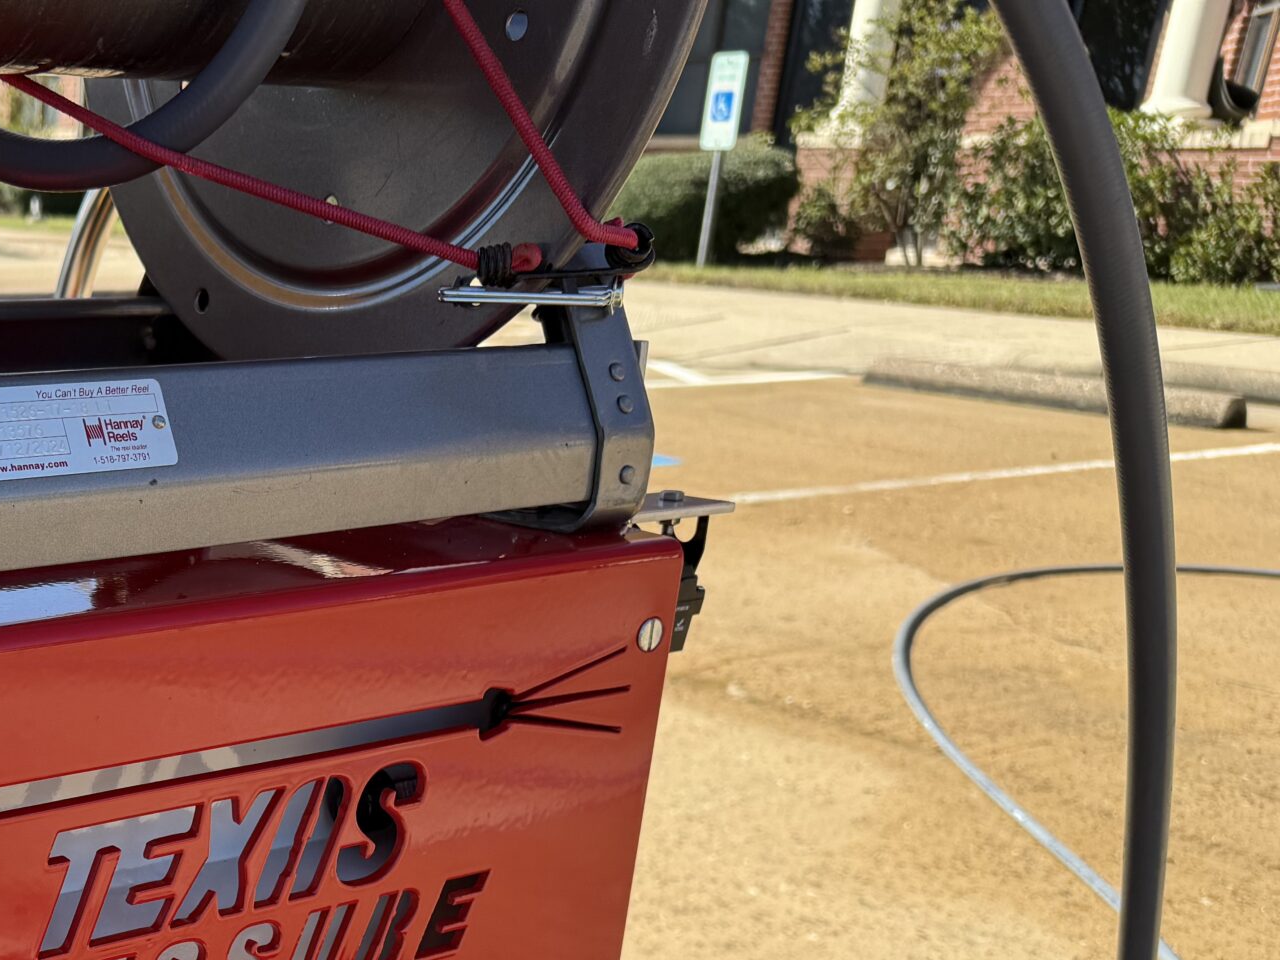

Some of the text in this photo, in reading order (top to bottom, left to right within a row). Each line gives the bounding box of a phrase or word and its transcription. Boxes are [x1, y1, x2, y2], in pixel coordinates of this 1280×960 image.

[36, 384, 150, 399] You Can't Buy A Better Reel
[104, 418, 144, 431] Hannay
[107, 430, 138, 443] Reels
[93, 452, 151, 465] 1-518-797-3791
[38, 761, 427, 960] TEXAS
